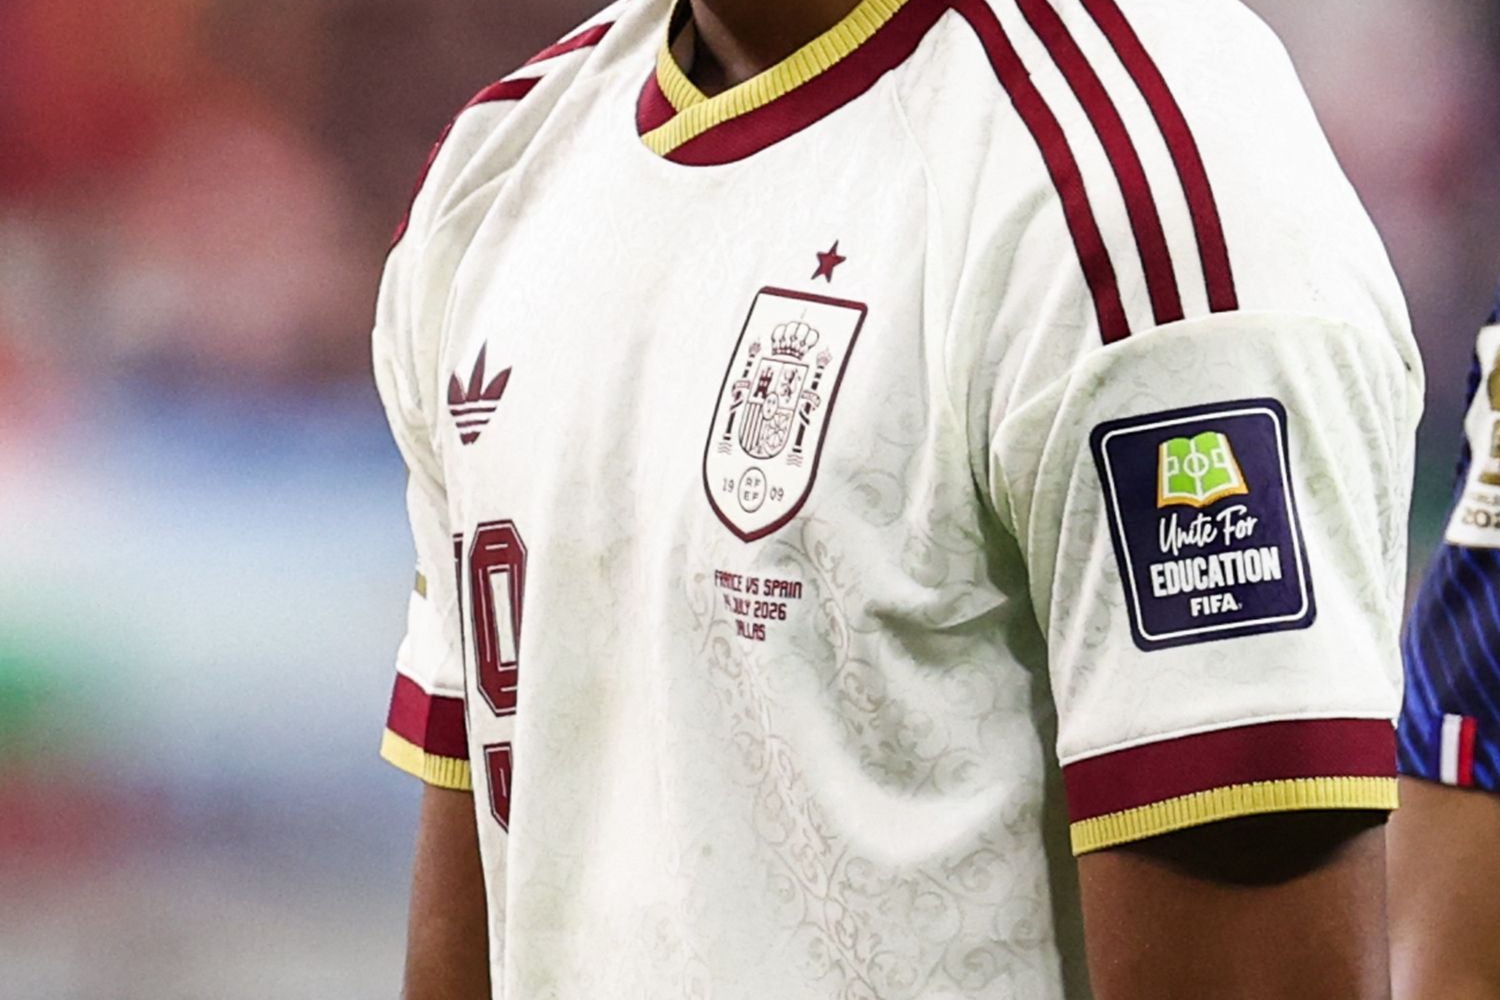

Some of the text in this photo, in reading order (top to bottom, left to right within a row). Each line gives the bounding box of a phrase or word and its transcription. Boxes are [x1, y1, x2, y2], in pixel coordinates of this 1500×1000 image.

[1159, 504, 1258, 556] Unite For
[1150, 546, 1282, 598] EDUCATION
[746, 577, 760, 596] VS
[763, 578, 803, 600] SPAIN
[754, 600, 788, 621] 2026
[1190, 592, 1239, 617] FIFA
